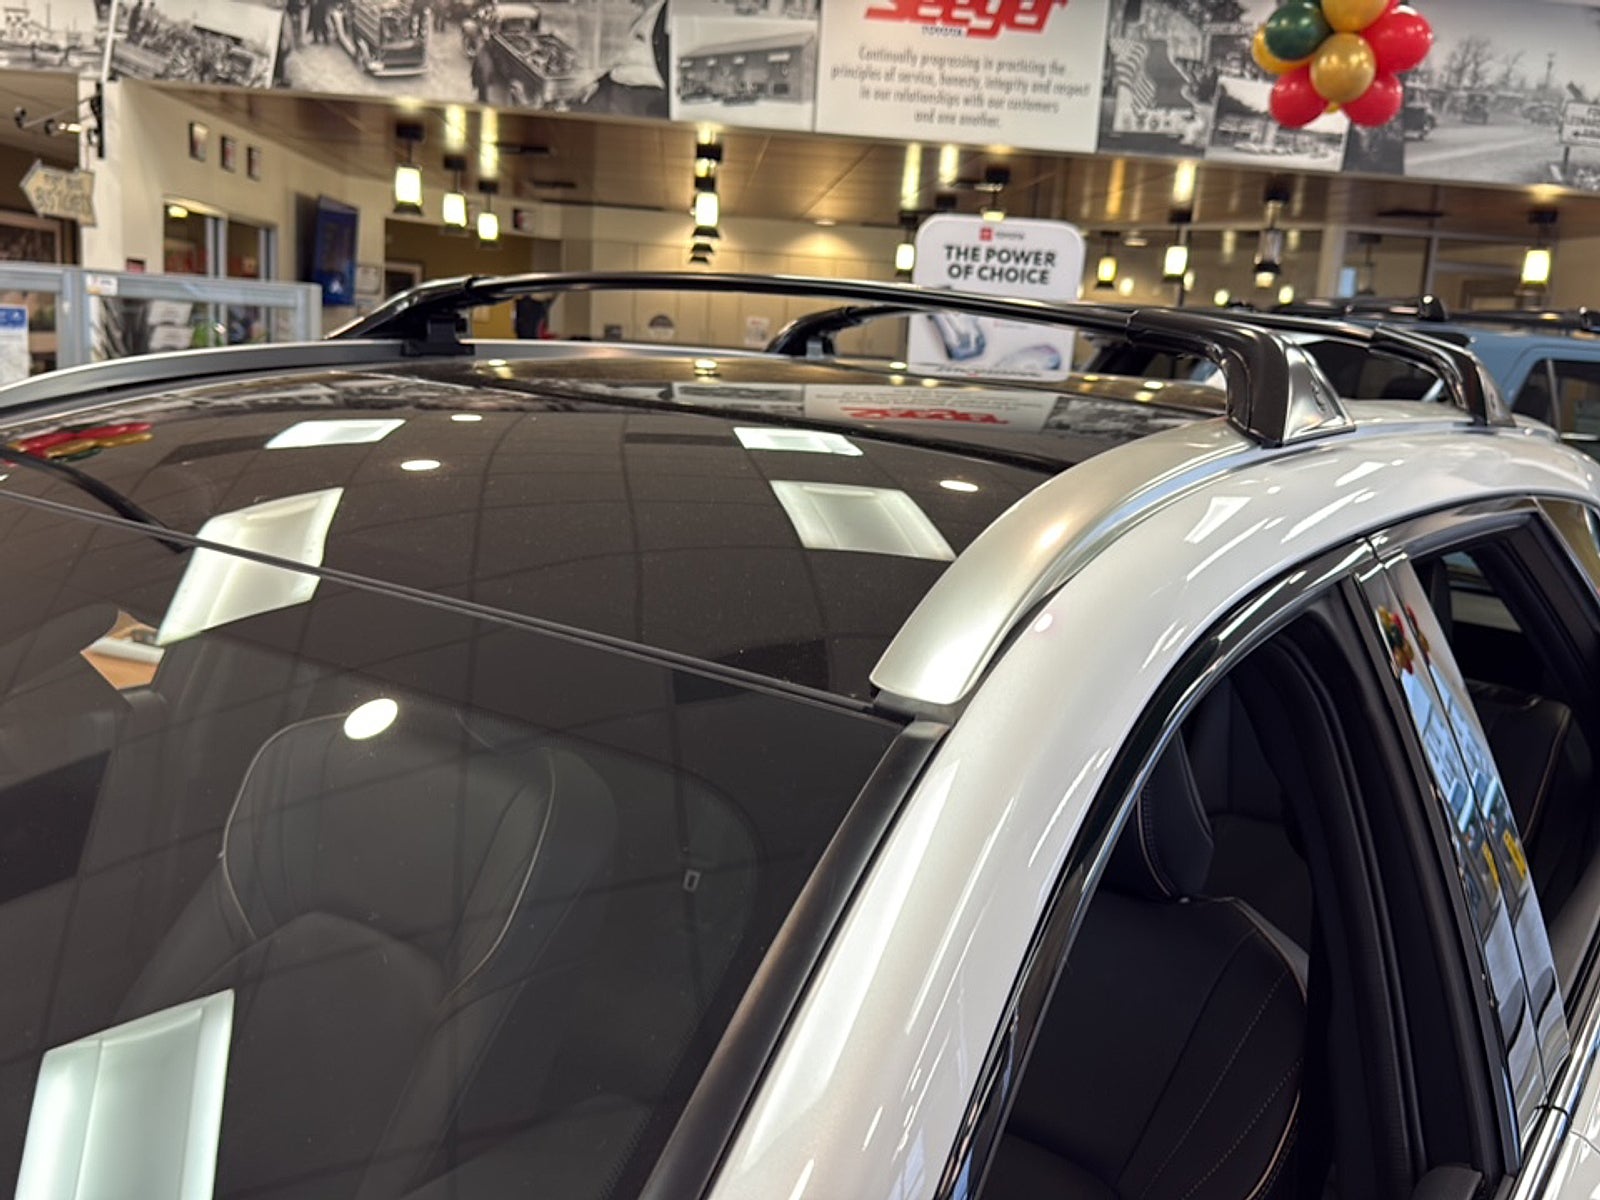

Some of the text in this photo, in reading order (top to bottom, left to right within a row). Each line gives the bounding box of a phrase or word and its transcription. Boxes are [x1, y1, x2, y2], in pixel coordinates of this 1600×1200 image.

[858, 45, 918, 67] Continually
[919, 53, 980, 72] progressing
[1049, 58, 1066, 74] the
[830, 65, 881, 82] principles
[883, 67, 896, 82] of
[983, 76, 1029, 95] integrity
[1031, 79, 1051, 95] and
[1053, 82, 1091, 98] respect
[873, 89, 891, 102] our
[893, 87, 960, 108] relationships
[962, 92, 983, 107] with
[987, 96, 1005, 109] our
[1007, 97, 1060, 114] customers
[914, 107, 936, 124] and
[937, 112, 956, 125] one
[944, 245, 1057, 267] THE POWER
[948, 264, 1050, 285] OF CHOICE
